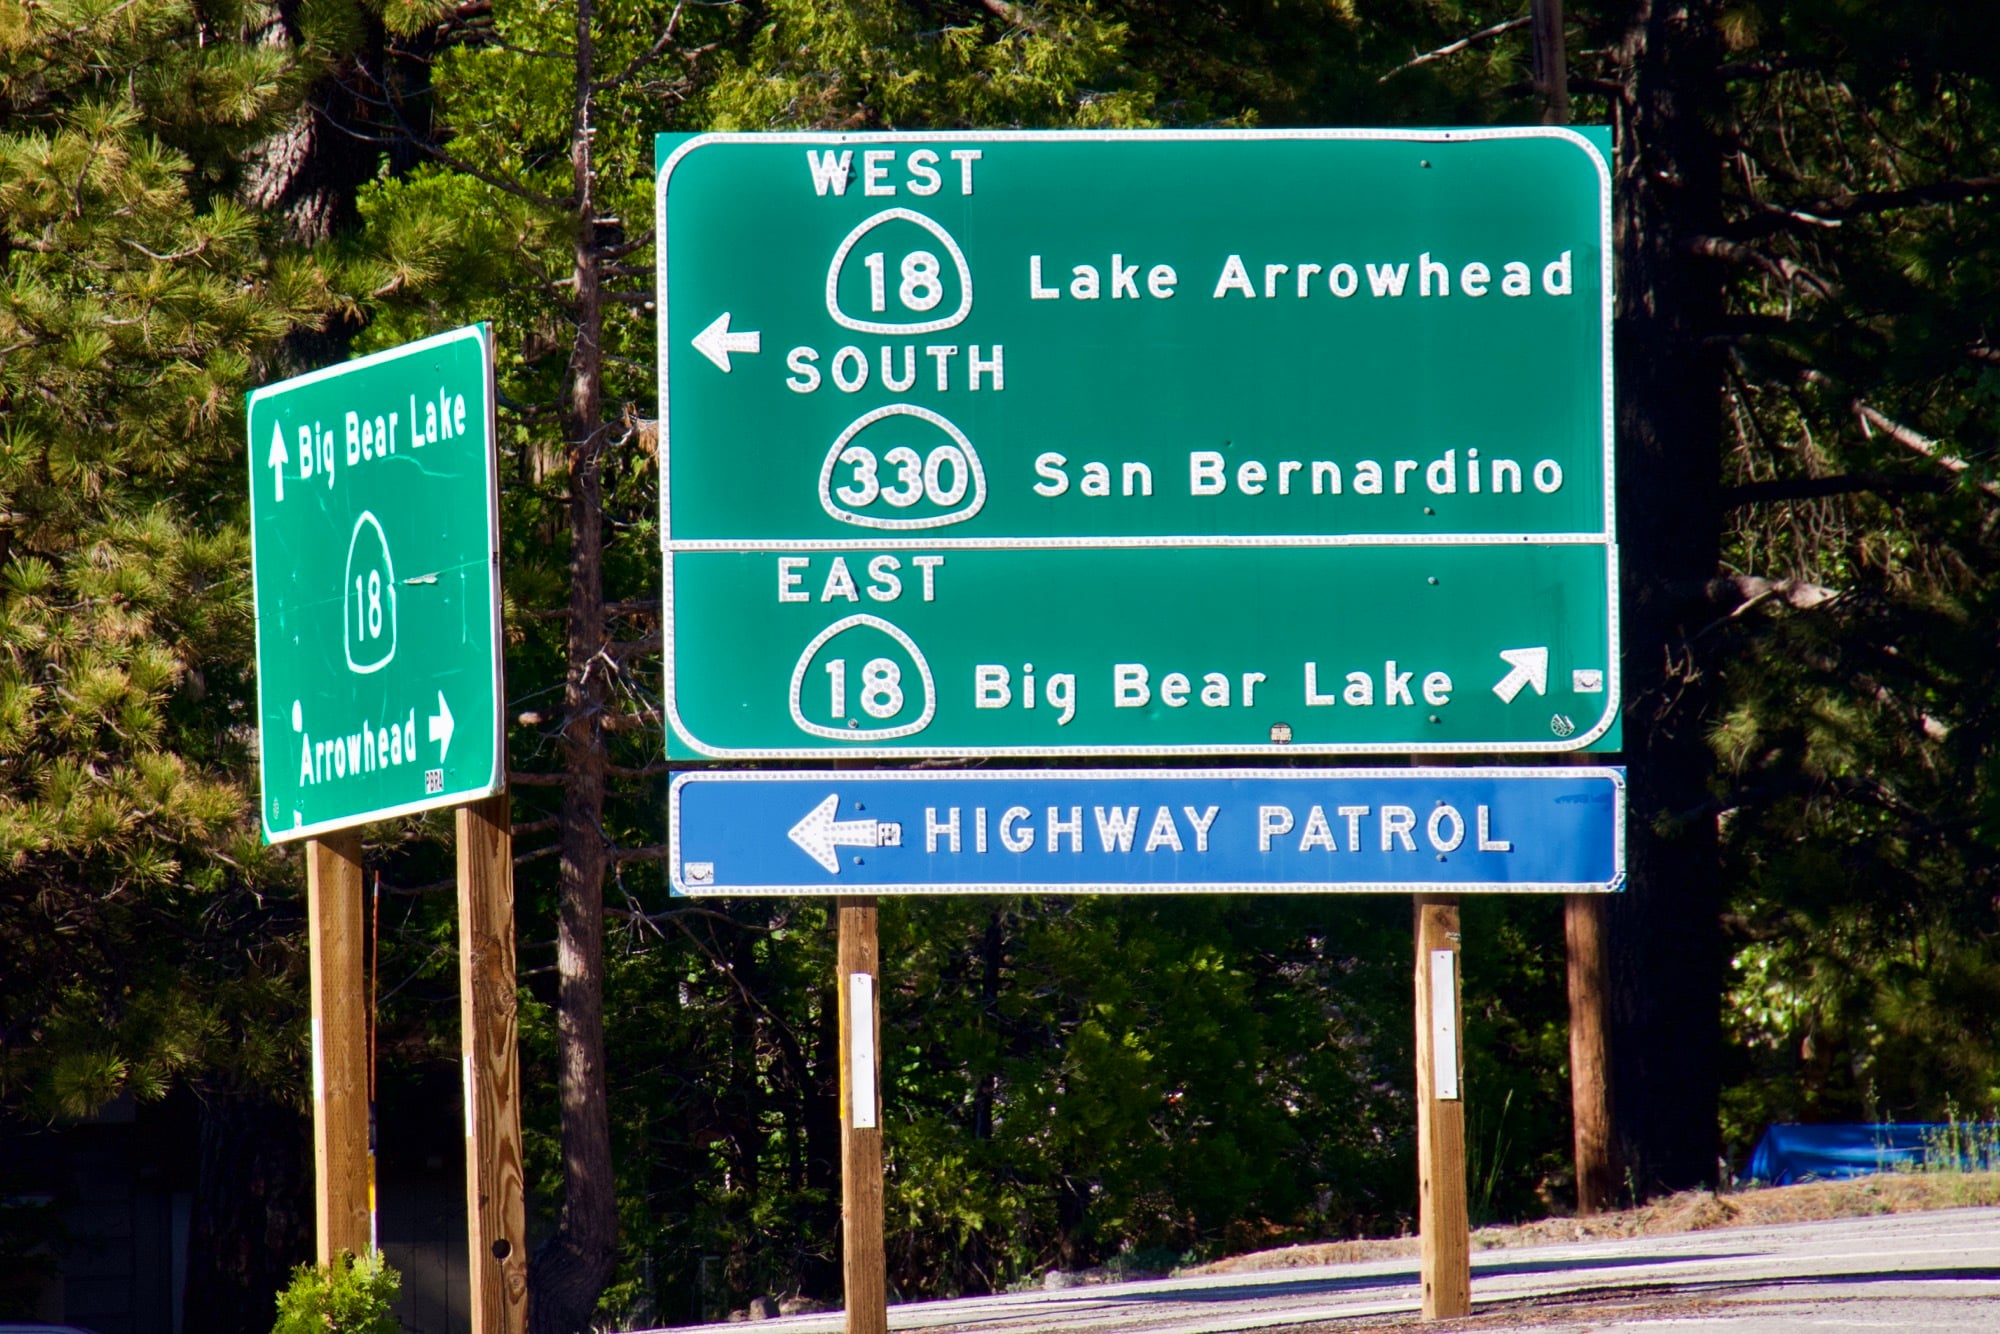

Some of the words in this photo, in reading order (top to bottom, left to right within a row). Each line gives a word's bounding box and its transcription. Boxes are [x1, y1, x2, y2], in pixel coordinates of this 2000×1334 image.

[806, 149, 983, 198] WEST
[863, 249, 944, 314] 18
[1029, 253, 1179, 300] Lake
[1212, 250, 1574, 300] Arrowhead
[785, 344, 1006, 395] SOUTH
[297, 420, 337, 490] Big
[345, 408, 399, 467] Bear
[409, 387, 468, 449] Lake
[835, 444, 970, 509] 330
[1032, 450, 1153, 498] San
[1188, 447, 1565, 497] Bernardino
[354, 568, 383, 642] 18
[778, 555, 946, 604] EAST
[824, 656, 905, 720] 18
[974, 662, 1077, 727] Big
[1112, 662, 1268, 709] Bear
[1303, 659, 1454, 707] Lake
[298, 707, 418, 789] Arrowhead
[923, 804, 1222, 855] HIGHWAY
[1257, 803, 1512, 854] PATROL
